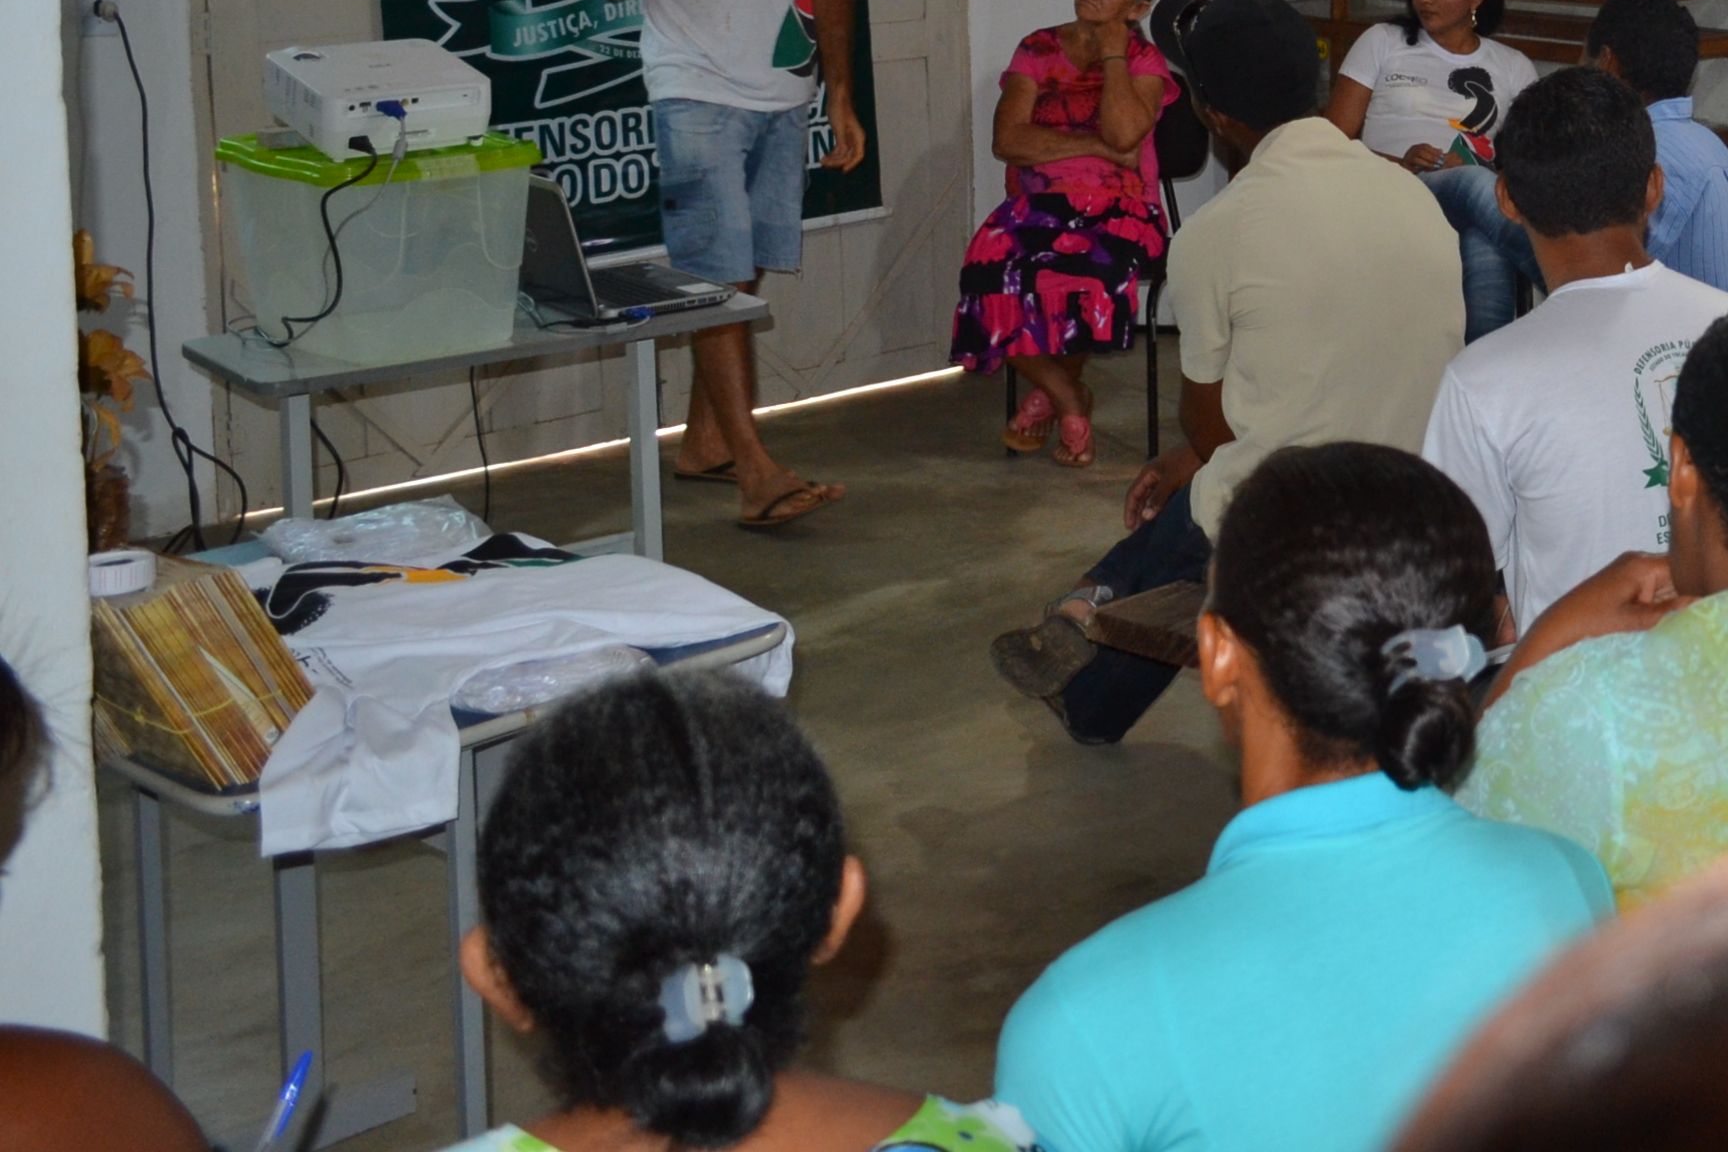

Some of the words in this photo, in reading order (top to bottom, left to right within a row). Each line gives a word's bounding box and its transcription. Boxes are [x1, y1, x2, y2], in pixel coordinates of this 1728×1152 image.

[513, 10, 599, 48] JUSTIÇA,
[592, 158, 646, 199] DO
[1633, 341, 1677, 375] DEFENSORIA
